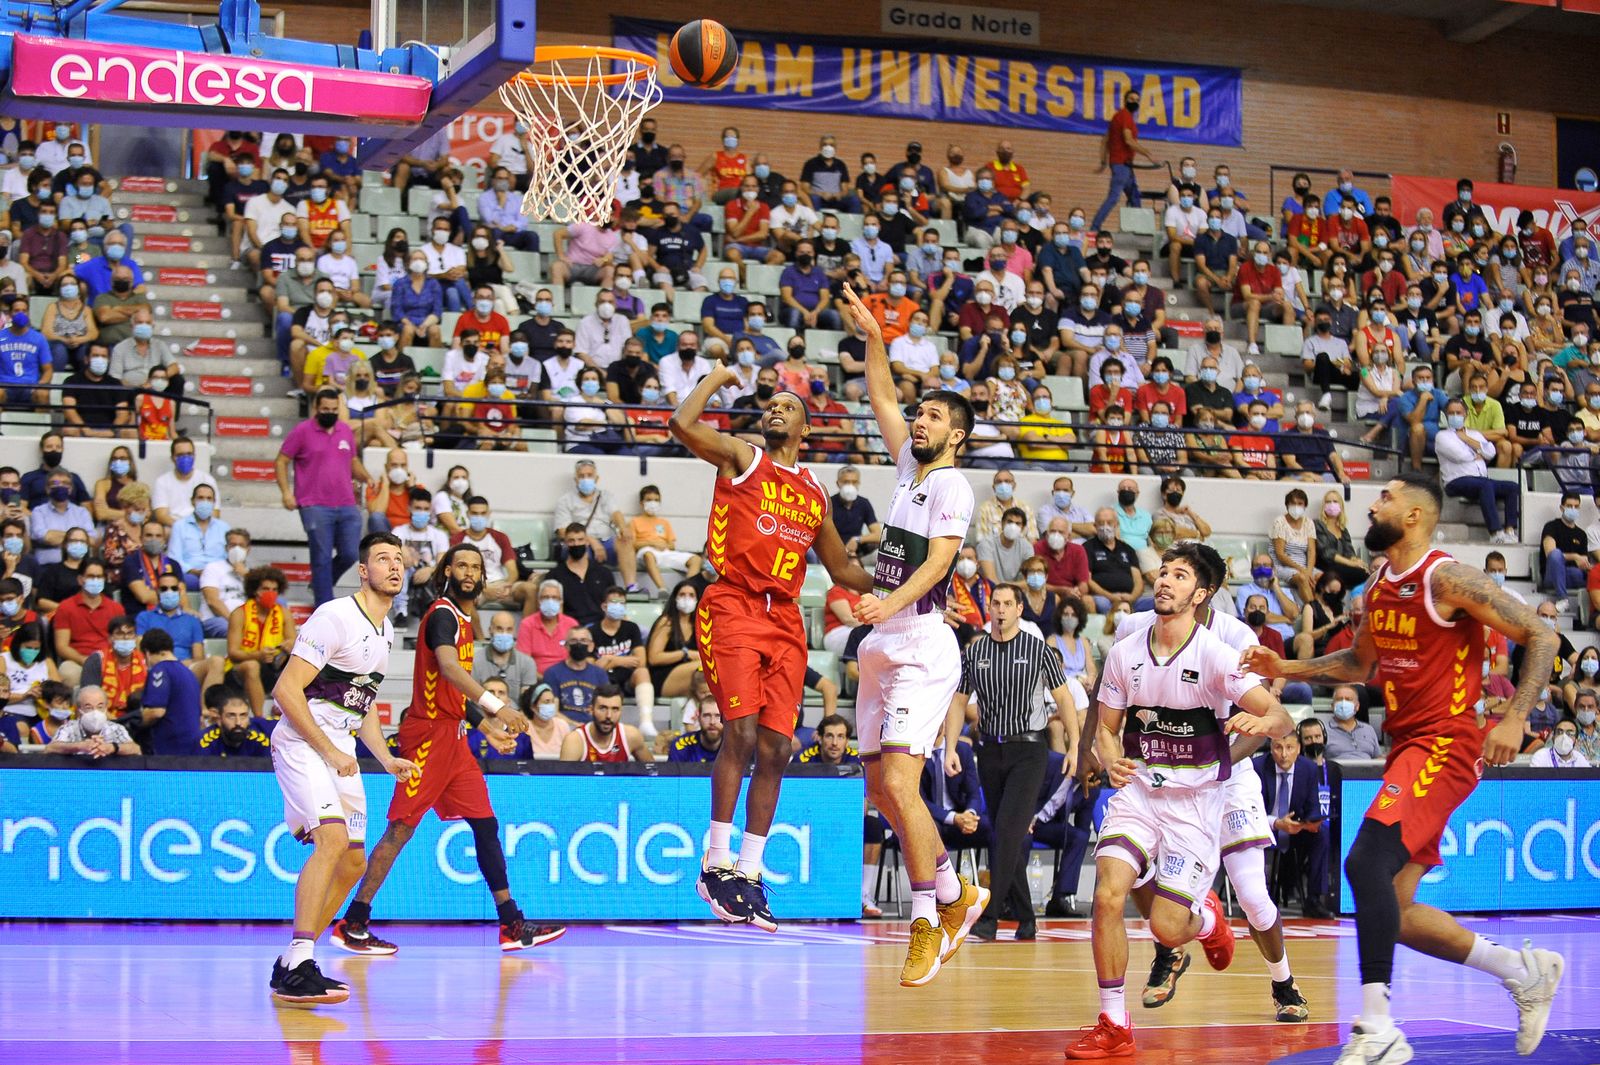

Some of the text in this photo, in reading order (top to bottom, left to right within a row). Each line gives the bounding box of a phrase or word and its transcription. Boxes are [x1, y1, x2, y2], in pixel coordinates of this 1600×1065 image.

[889, 7, 1032, 36] Grada Norte
[50, 50, 314, 112] endesa
[656, 33, 814, 97] UAM
[841, 47, 1201, 129] UNIVERSIDAD
[771, 547, 800, 581] 12
[1385, 680, 1398, 711] 6
[1156, 720, 1194, 736] Unicaja
[1151, 739, 1193, 753] MÁLAGA
